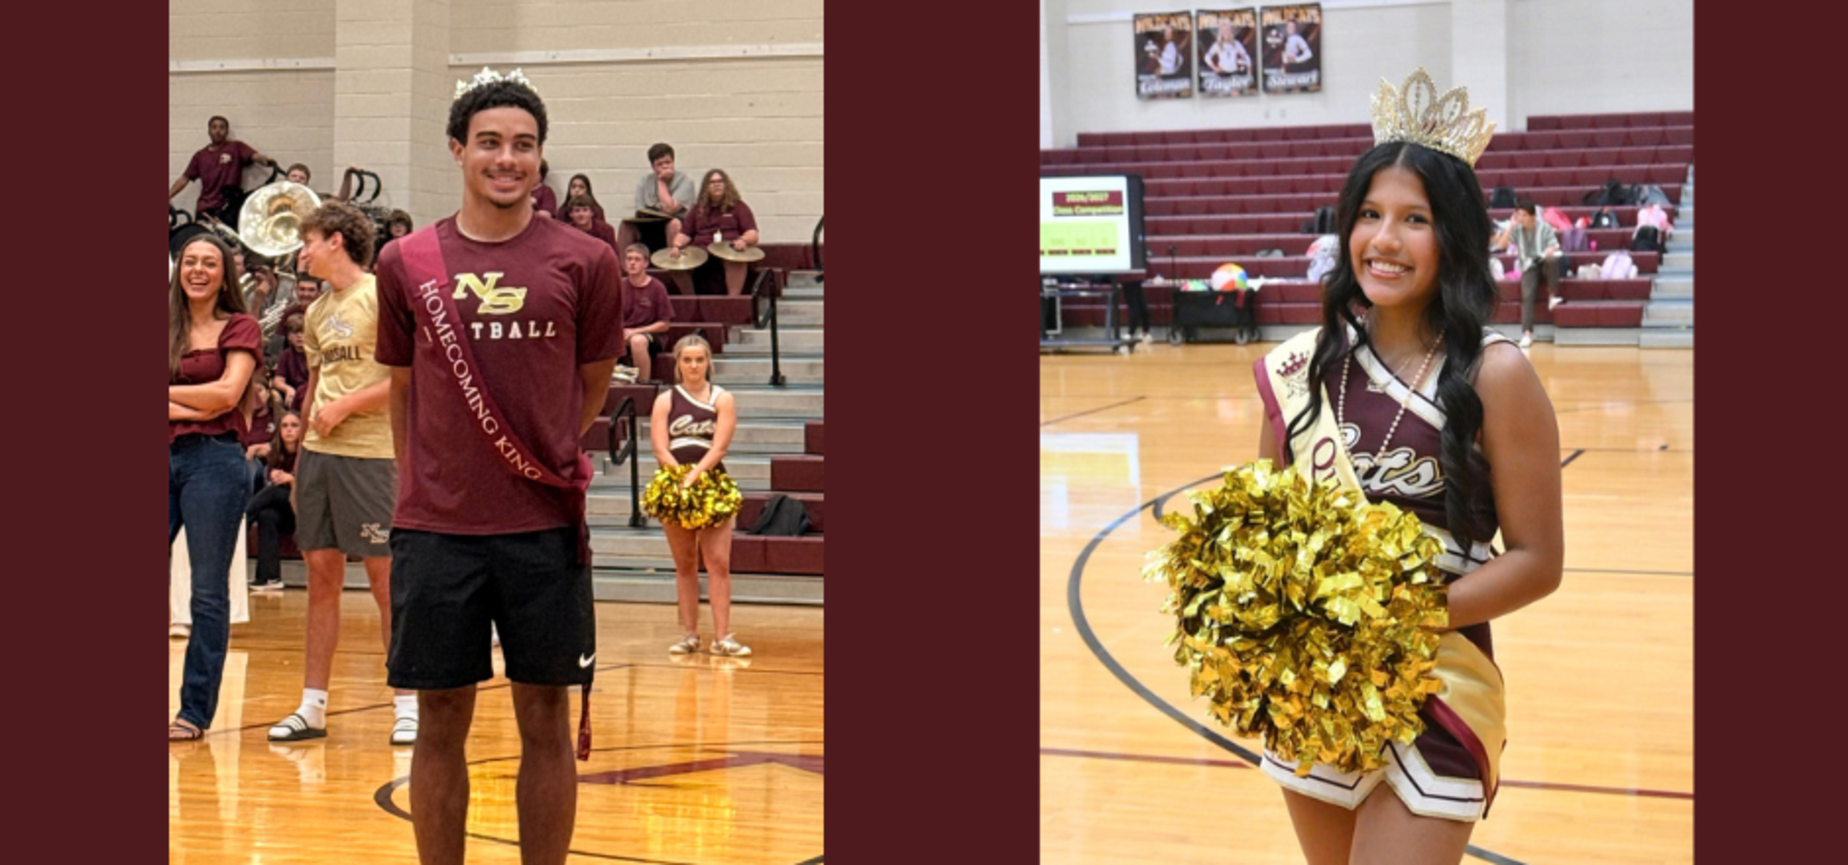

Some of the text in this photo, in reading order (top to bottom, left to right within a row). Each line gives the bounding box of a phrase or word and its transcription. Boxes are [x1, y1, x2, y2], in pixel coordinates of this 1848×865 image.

[452, 271, 528, 314] NS
[471, 320, 556, 339] TBALL
[419, 279, 543, 481] HOMECOMING KING
